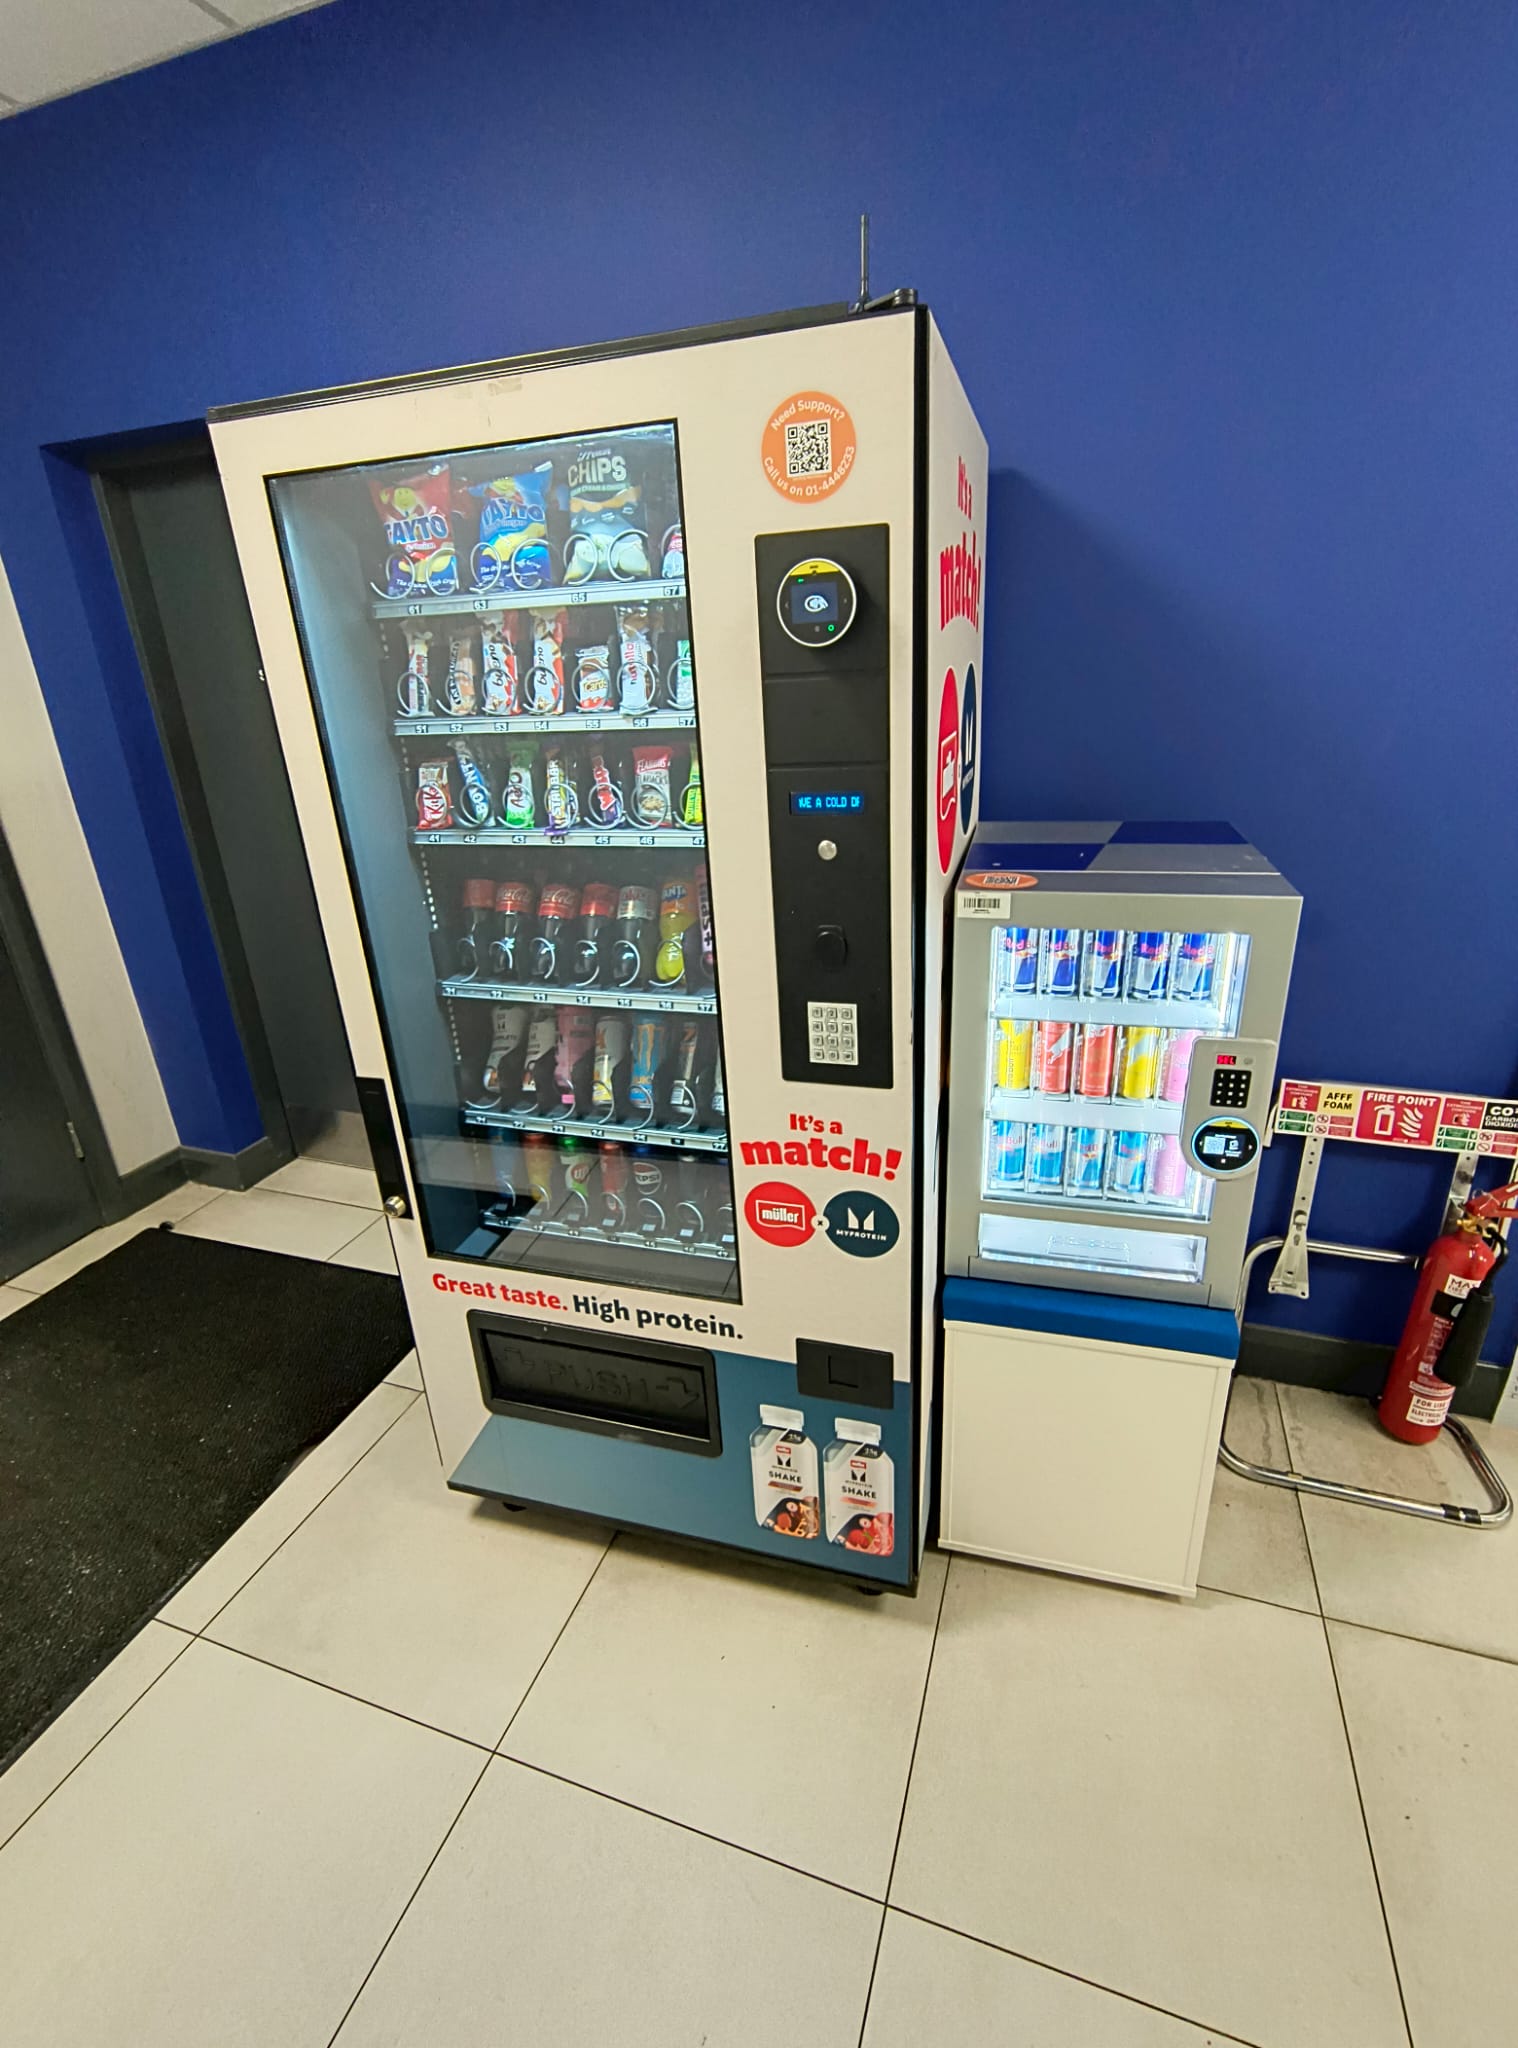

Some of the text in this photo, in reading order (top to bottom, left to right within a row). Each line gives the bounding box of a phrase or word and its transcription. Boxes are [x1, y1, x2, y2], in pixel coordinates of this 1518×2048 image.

[770, 399, 846, 431] Need Support?
[567, 454, 627, 488] CHIPS
[764, 456, 780, 480] Call
[776, 478, 788, 491] us
[789, 486, 803, 497] on
[939, 530, 982, 633] match!
[408, 586, 681, 615] 61 63 65 67
[415, 718, 694, 734] 51 52 53 54 55 56 57
[815, 797, 822, 808] A
[825, 796, 848, 808] COLD
[429, 834, 441, 844] 41
[464, 834, 477, 844] 42
[512, 835, 526, 845] 43
[595, 836, 609, 845] 45
[640, 836, 654, 846] 46
[693, 837, 704, 846] 47
[1326, 1091, 1354, 1102] AFFF
[1366, 1092, 1437, 1107] FIRE POINT
[1322, 1100, 1353, 1111] FOAM
[789, 1113, 843, 1135] It's a
[739, 1137, 903, 1181] match!
[761, 1207, 800, 1224] müller
[835, 1229, 888, 1241] MYPROTEIN
[432, 1273, 743, 1340] Great taste. High protein.
[544, 1359, 649, 1403] PUSH
[768, 1470, 802, 1484] SHAKE
[841, 1485, 877, 1499] SHAKE
